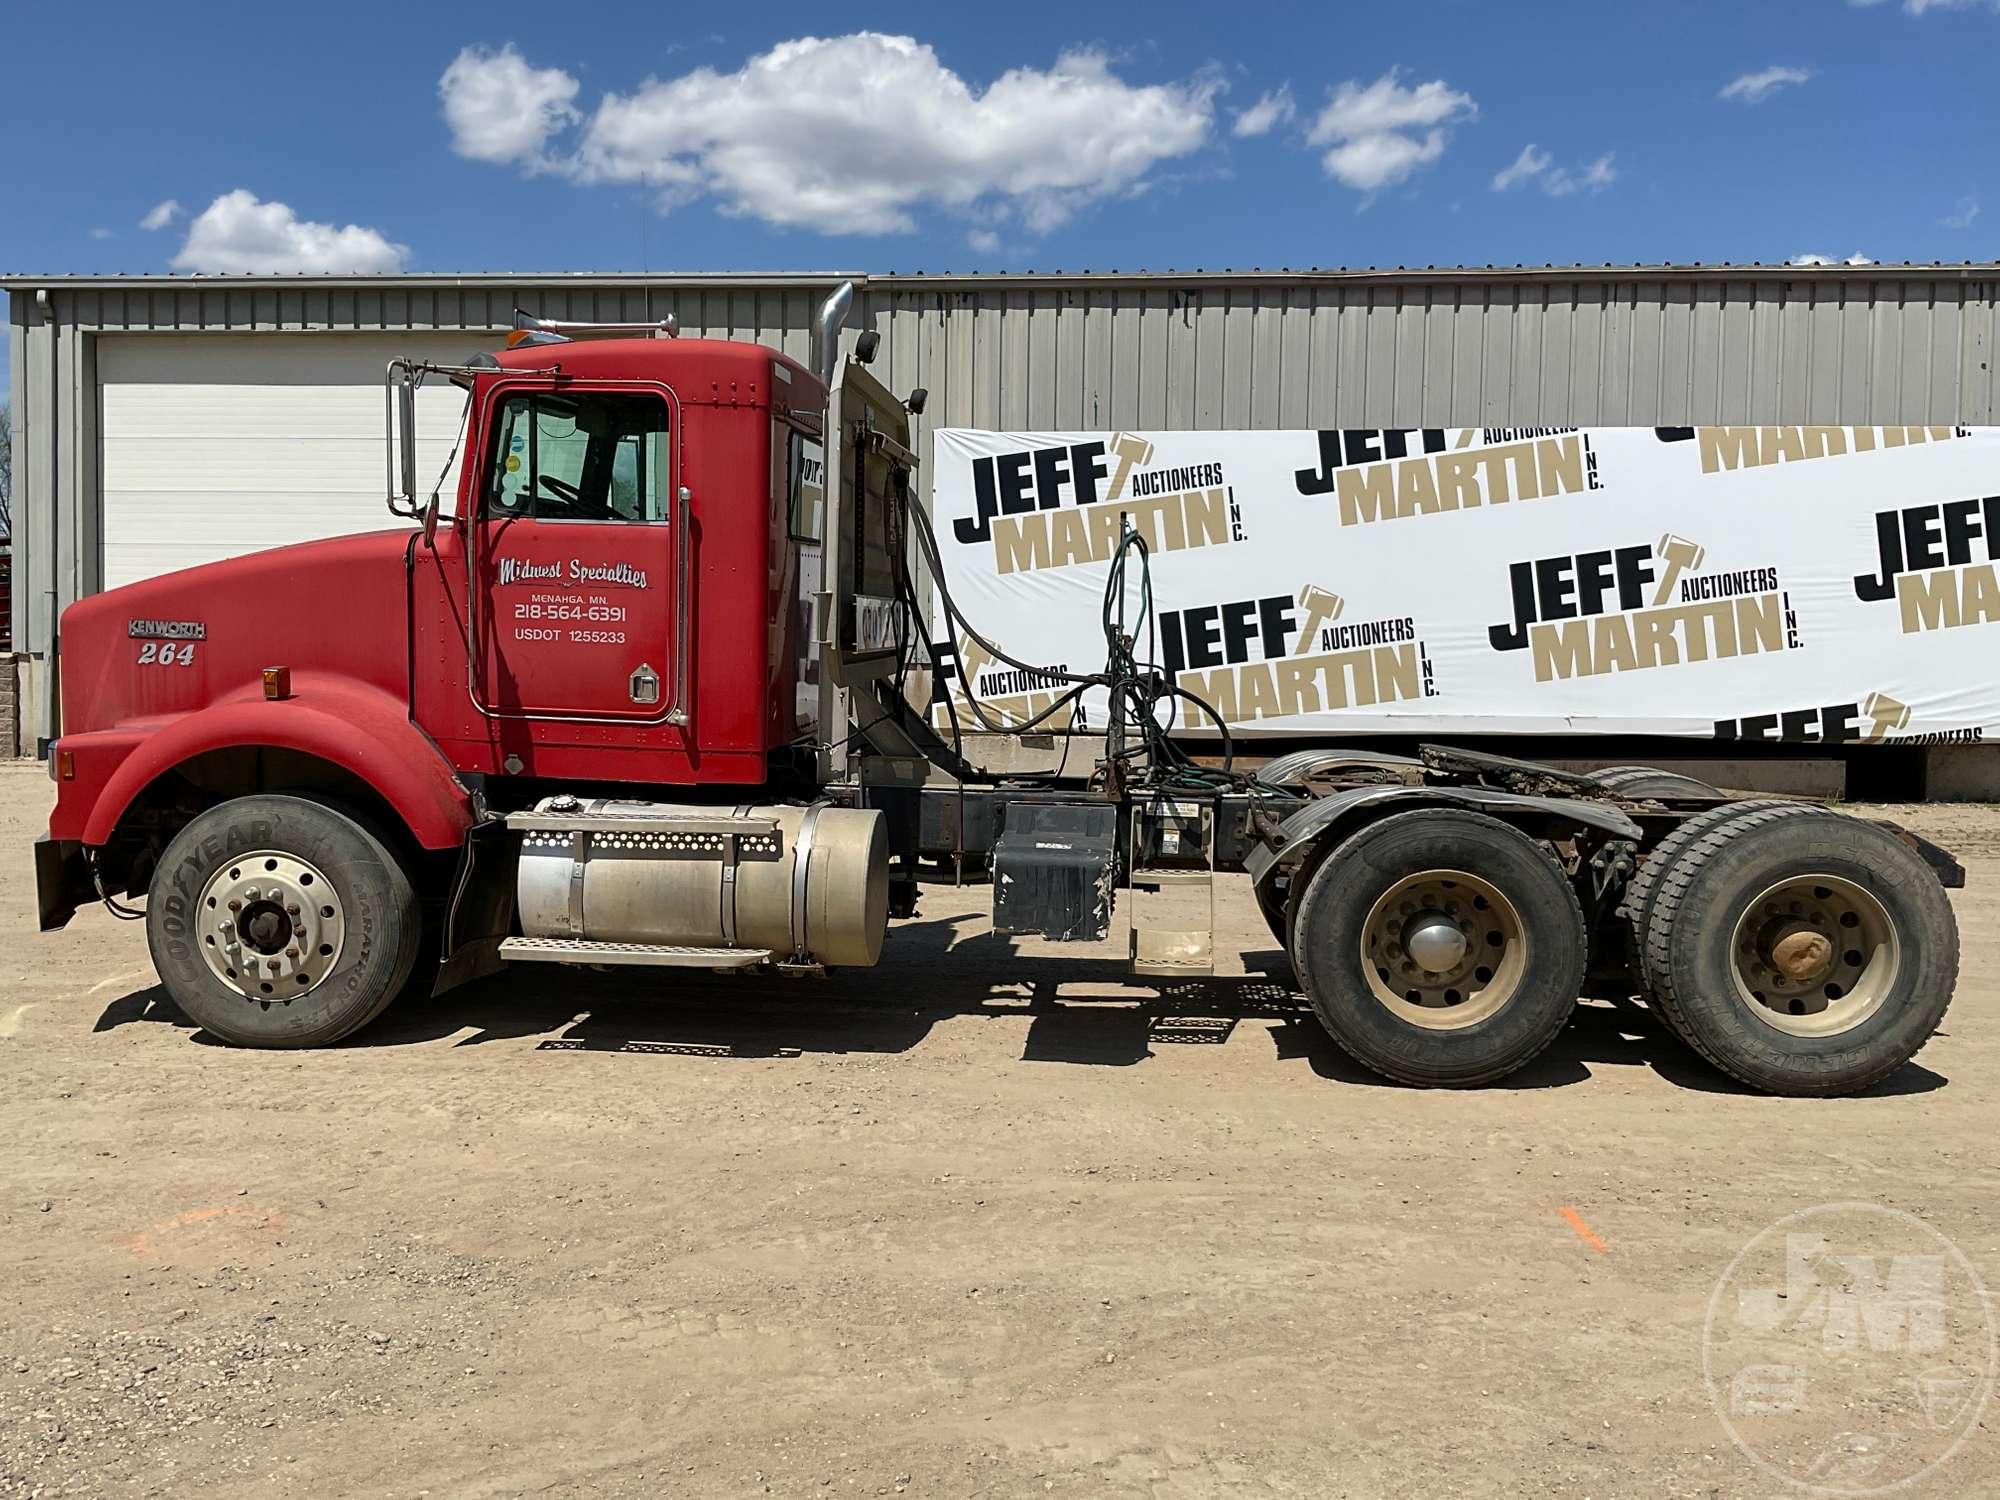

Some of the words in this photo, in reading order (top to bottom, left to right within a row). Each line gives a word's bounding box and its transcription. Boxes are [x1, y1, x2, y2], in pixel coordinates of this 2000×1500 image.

[953, 441, 1107, 544] JEFF
[1132, 462, 1223, 497] AUCTIONEERS
[1336, 436, 1584, 526] MARTIN
[992, 489, 1229, 575] MARTIN
[500, 558, 562, 585] Midwest
[570, 559, 647, 589] Specialties
[1681, 567, 1778, 602] AUCTIONEERS
[515, 604, 626, 621] 218-564-6391
[1488, 544, 1655, 651] JEFF
[129, 620, 205, 636] KENWORTH
[515, 628, 561, 641] USDOT
[569, 630, 626, 643] 1255233
[1322, 617, 1415, 651] AUCTIONEERS
[1530, 593, 1784, 683] MARTIN
[138, 643, 195, 666] 264
[1179, 643, 1420, 728] MARTIN
